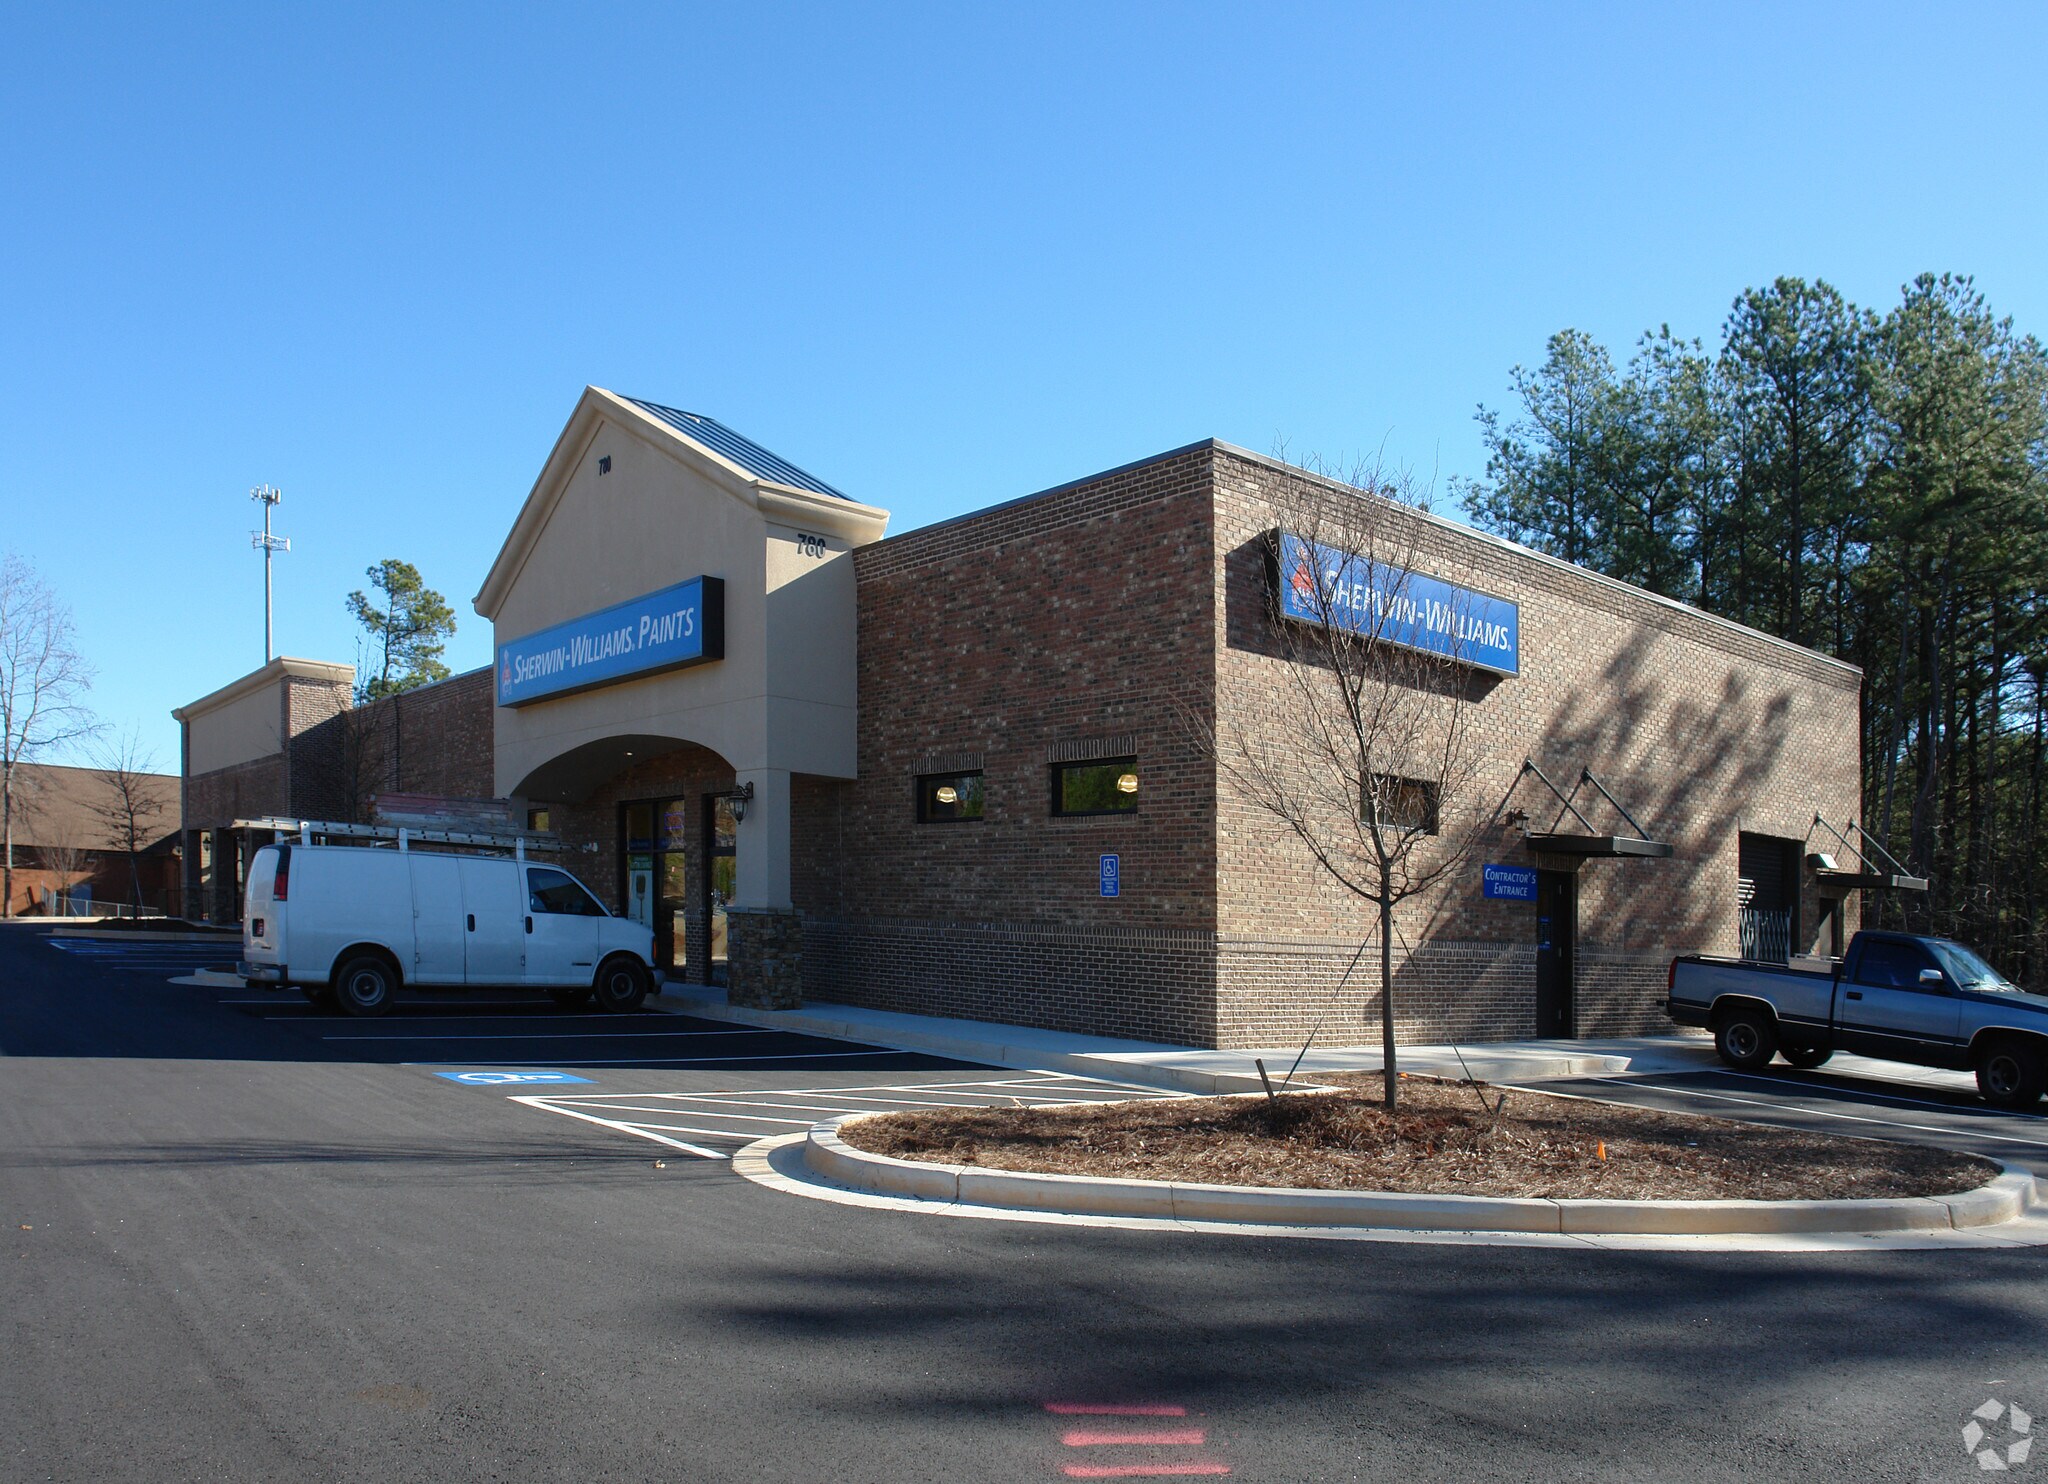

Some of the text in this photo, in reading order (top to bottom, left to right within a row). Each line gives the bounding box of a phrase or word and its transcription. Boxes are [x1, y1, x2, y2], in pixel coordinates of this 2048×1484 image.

[797, 533, 826, 559] 780
[638, 607, 694, 649] PAINTS
[1485, 868, 1536, 884] CONTRACTOR'S
[1494, 883, 1528, 896] ENTRANCE
